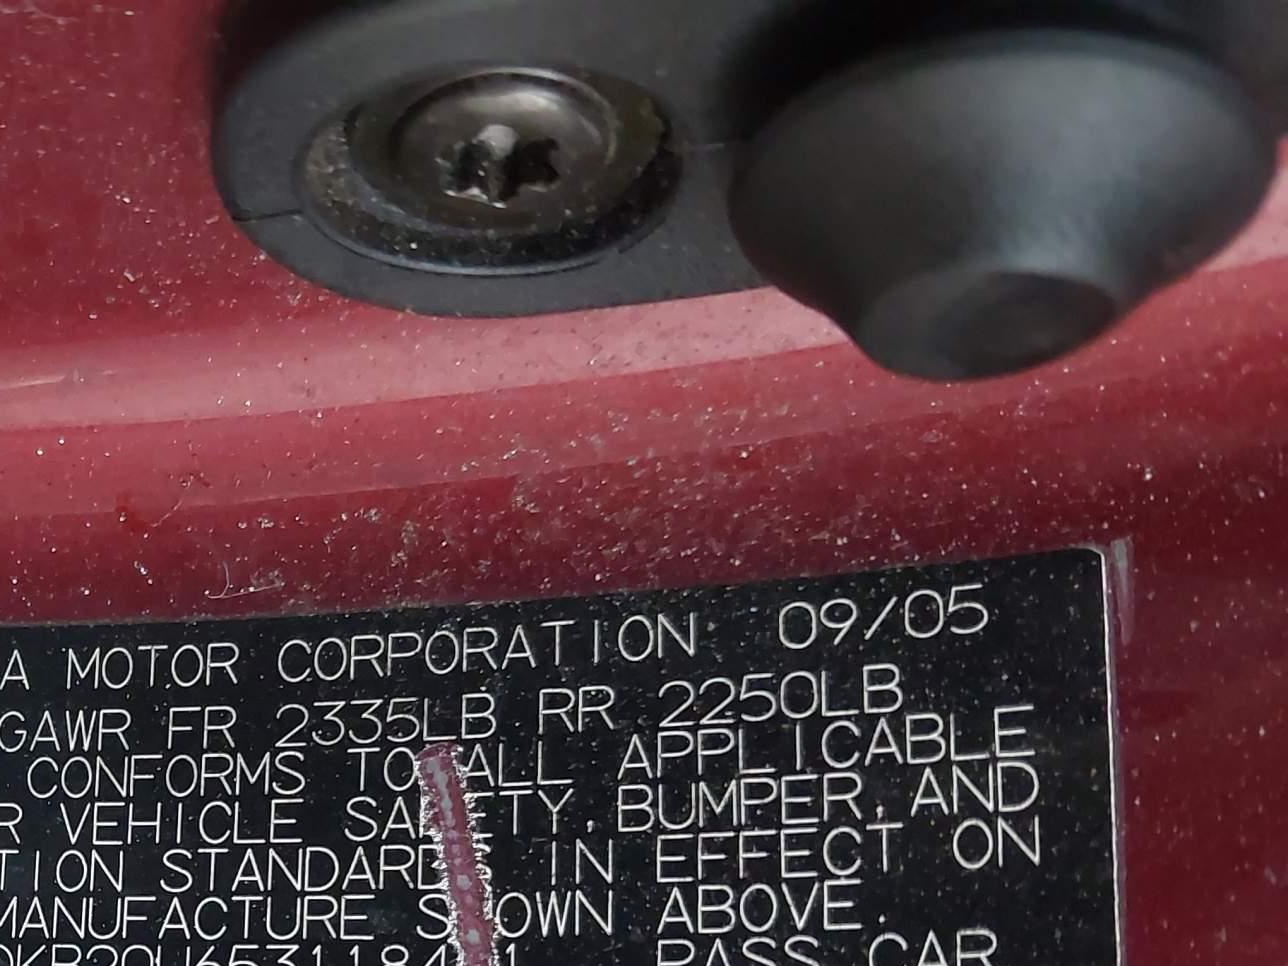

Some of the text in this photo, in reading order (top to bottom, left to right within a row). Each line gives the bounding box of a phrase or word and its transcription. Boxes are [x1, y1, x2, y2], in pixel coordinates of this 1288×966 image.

[66, 642, 239, 690] MOTOR
[278, 612, 697, 681] CORPORATION
[778, 584, 990, 651] 09/05
[168, 705, 237, 749] FR
[276, 693, 496, 747] 2335LB
[538, 686, 615, 735] RR
[658, 662, 905, 730] 2250LB
[27, 749, 307, 800] CONFORMS
[347, 746, 419, 792] TO
[463, 740, 574, 789] ALL
[617, 704, 1037, 780] APPLICABLE
[62, 797, 304, 846] VEHICLE
[911, 758, 1041, 818] AND
[549, 837, 613, 887] IN
[656, 821, 904, 885] EFFECT
[951, 816, 1042, 872] ON
[416, 889, 614, 941] SOWN
[656, 879, 886, 939] ABOVE.
